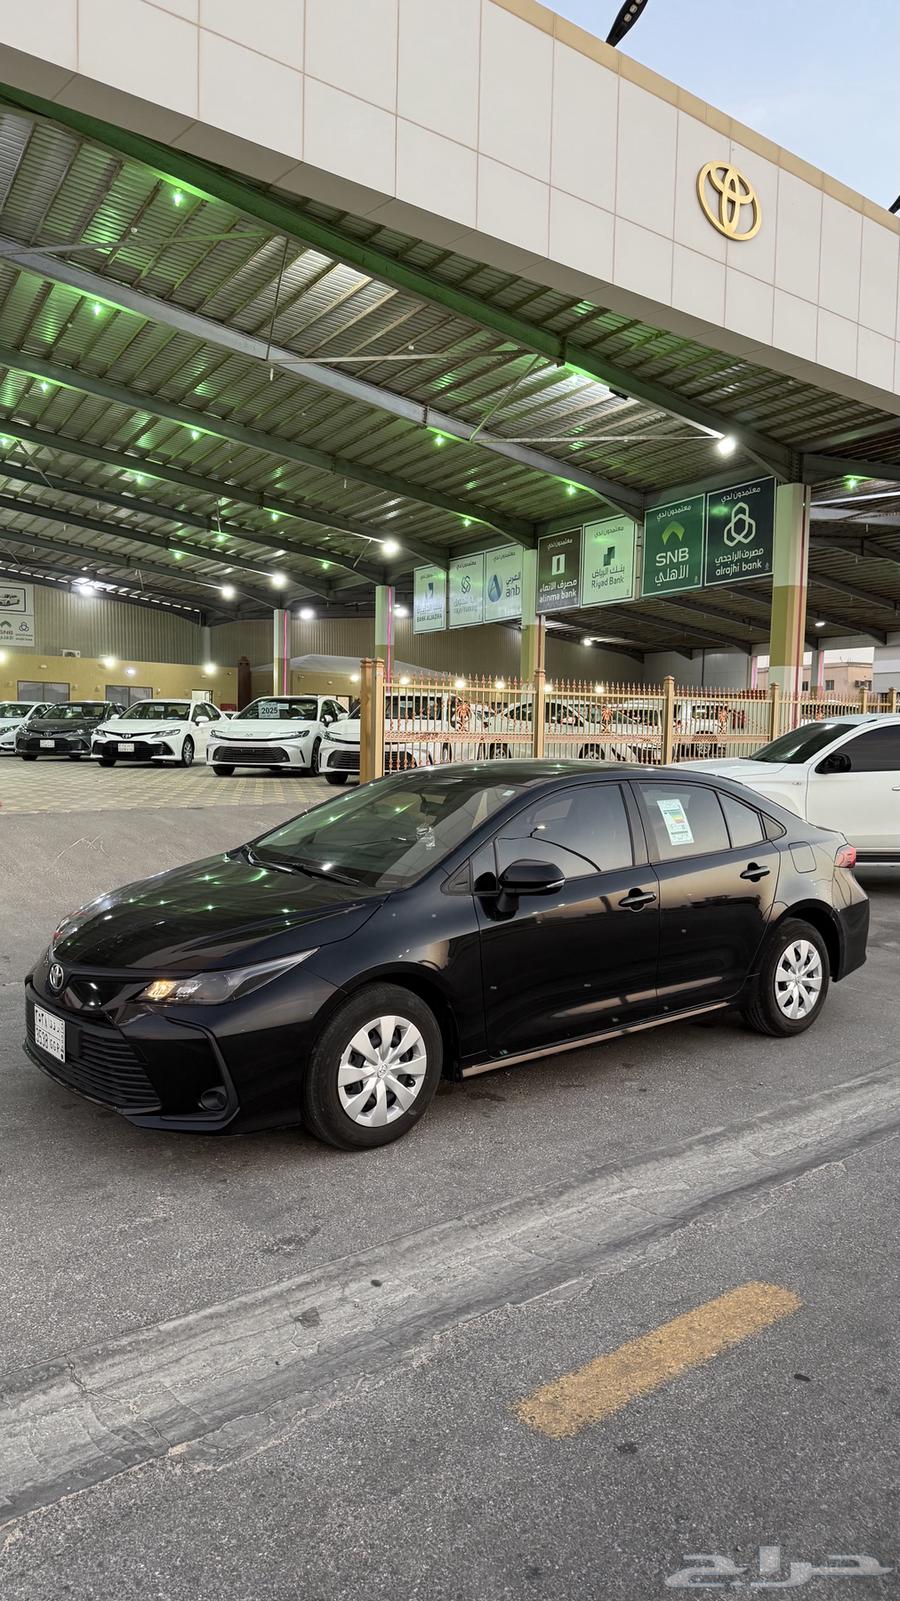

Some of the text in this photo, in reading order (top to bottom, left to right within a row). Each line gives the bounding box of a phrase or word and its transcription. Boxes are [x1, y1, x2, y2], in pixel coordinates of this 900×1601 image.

[655, 547, 689, 567] SNB
[741, 548, 764, 559] مصرف
[715, 559, 762, 576] alrajhi bank
[591, 575, 624, 589] Riyad Bank
[506, 584, 521, 597] anb
[539, 588, 577, 603] alinma bank
